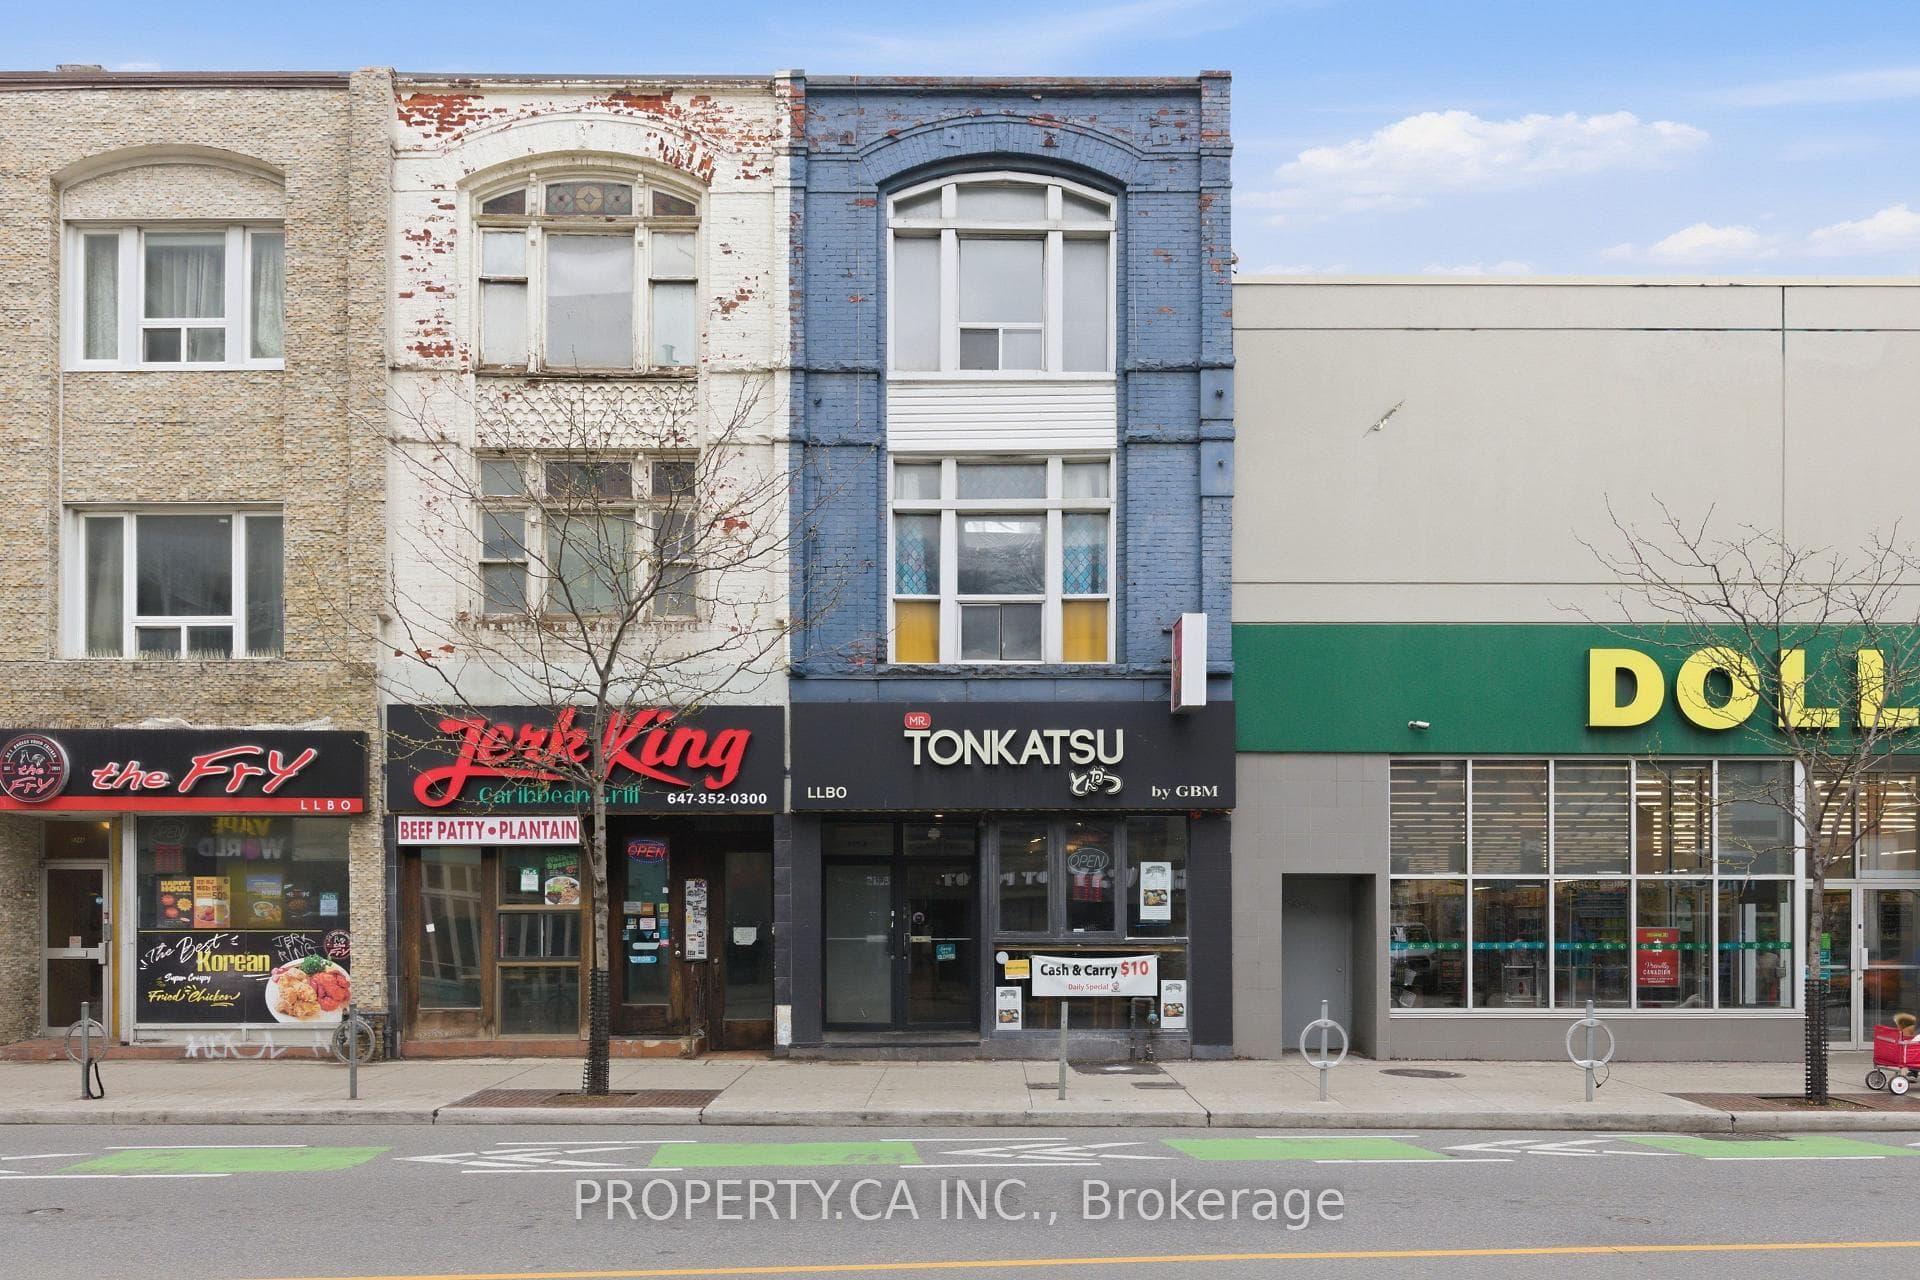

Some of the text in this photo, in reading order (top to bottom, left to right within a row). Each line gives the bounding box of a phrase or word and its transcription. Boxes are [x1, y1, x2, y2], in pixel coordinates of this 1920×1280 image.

[1589, 646, 1919, 729] DOLL
[903, 729, 1124, 766] TONKATSU
[413, 707, 752, 808] Jerk King
[91, 761, 169, 791] the
[479, 783, 641, 805] Caribbean rill
[667, 792, 767, 805] 647-352-0300
[807, 786, 847, 799] LLBO
[1151, 784, 1219, 801] by GBM
[301, 800, 351, 811] LLBO
[400, 819, 578, 840] BEEF PATTY PLANTAIN
[628, 845, 666, 857] OPEN
[1069, 854, 1105, 868] OPEN
[145, 933, 229, 963] The Best
[196, 951, 271, 972] Korean
[1041, 963, 1069, 976] Cash
[1072, 964, 1081, 976] &
[1084, 965, 1118, 979] Carry
[1120, 960, 1149, 977] $10
[164, 973, 211, 984] Super Crispy
[1068, 983, 1085, 991] Daily
[1085, 983, 1109, 991] Special
[147, 988, 241, 1002] Fried Chicken
